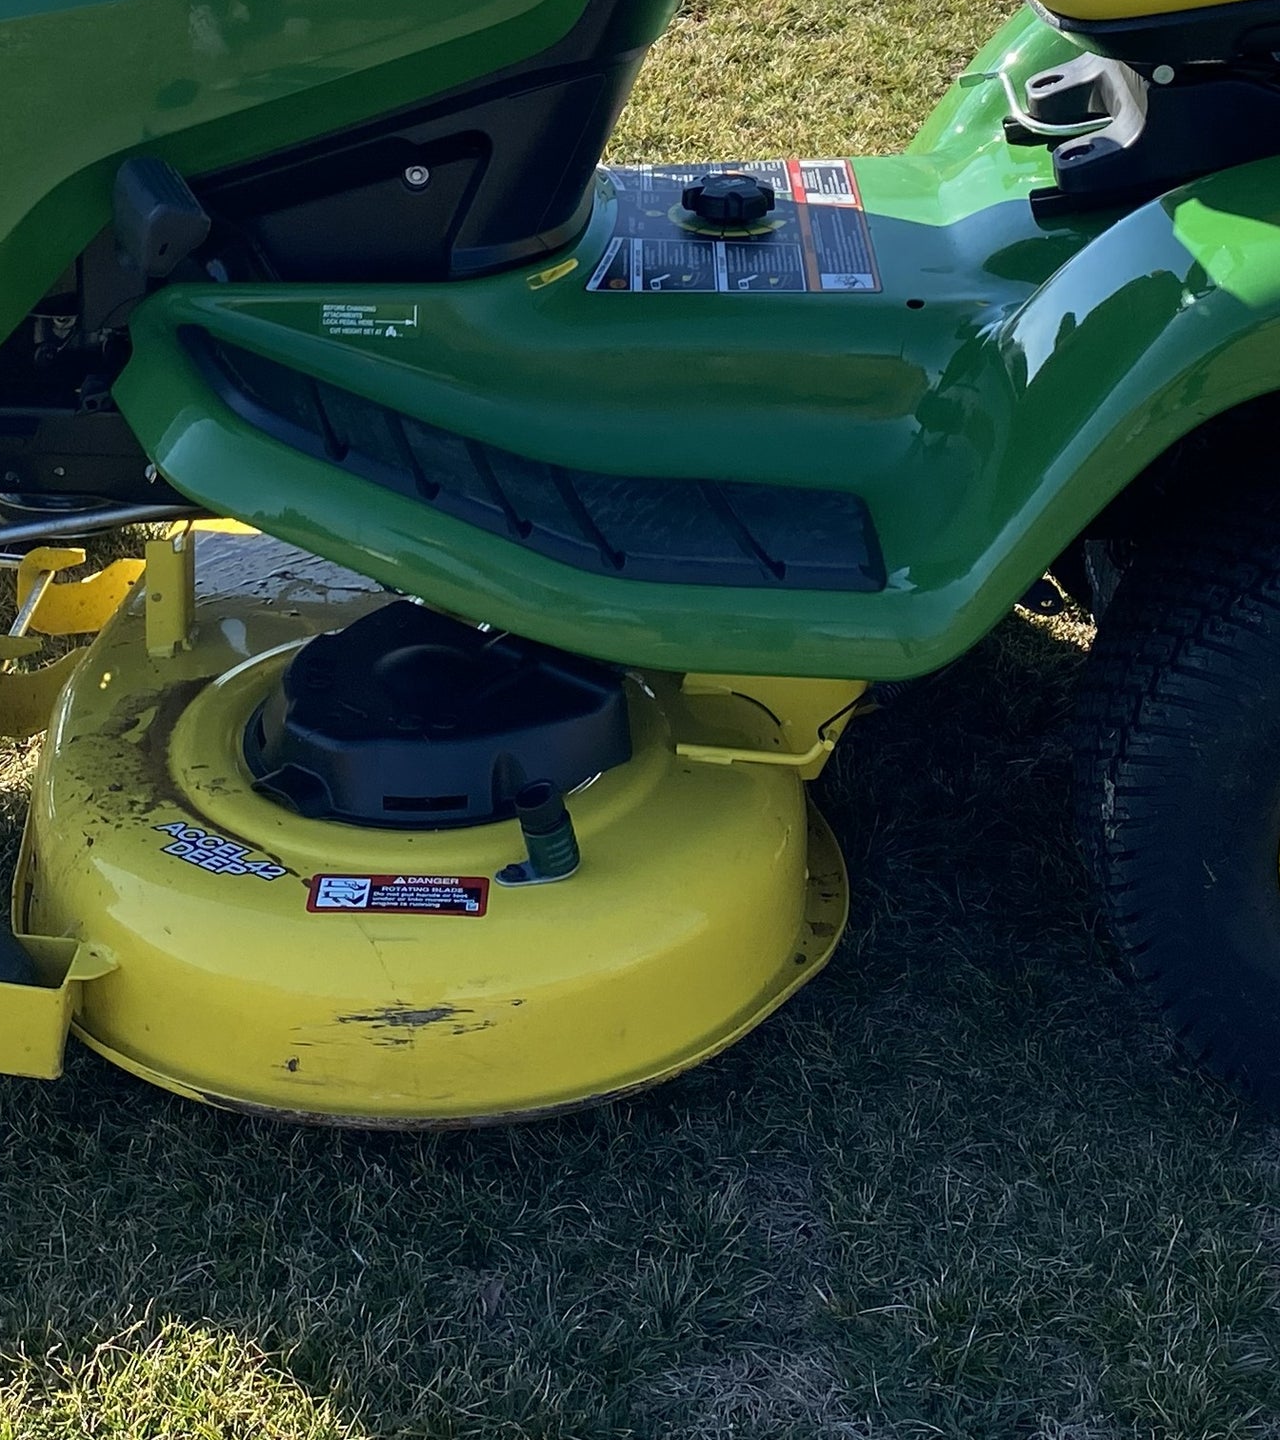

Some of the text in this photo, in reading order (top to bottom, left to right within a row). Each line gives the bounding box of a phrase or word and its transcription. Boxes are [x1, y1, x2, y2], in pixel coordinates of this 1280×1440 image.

[153, 821, 252, 865] ACCEL
[162, 840, 248, 875] DEEP
[407, 877, 459, 885] DANGER
